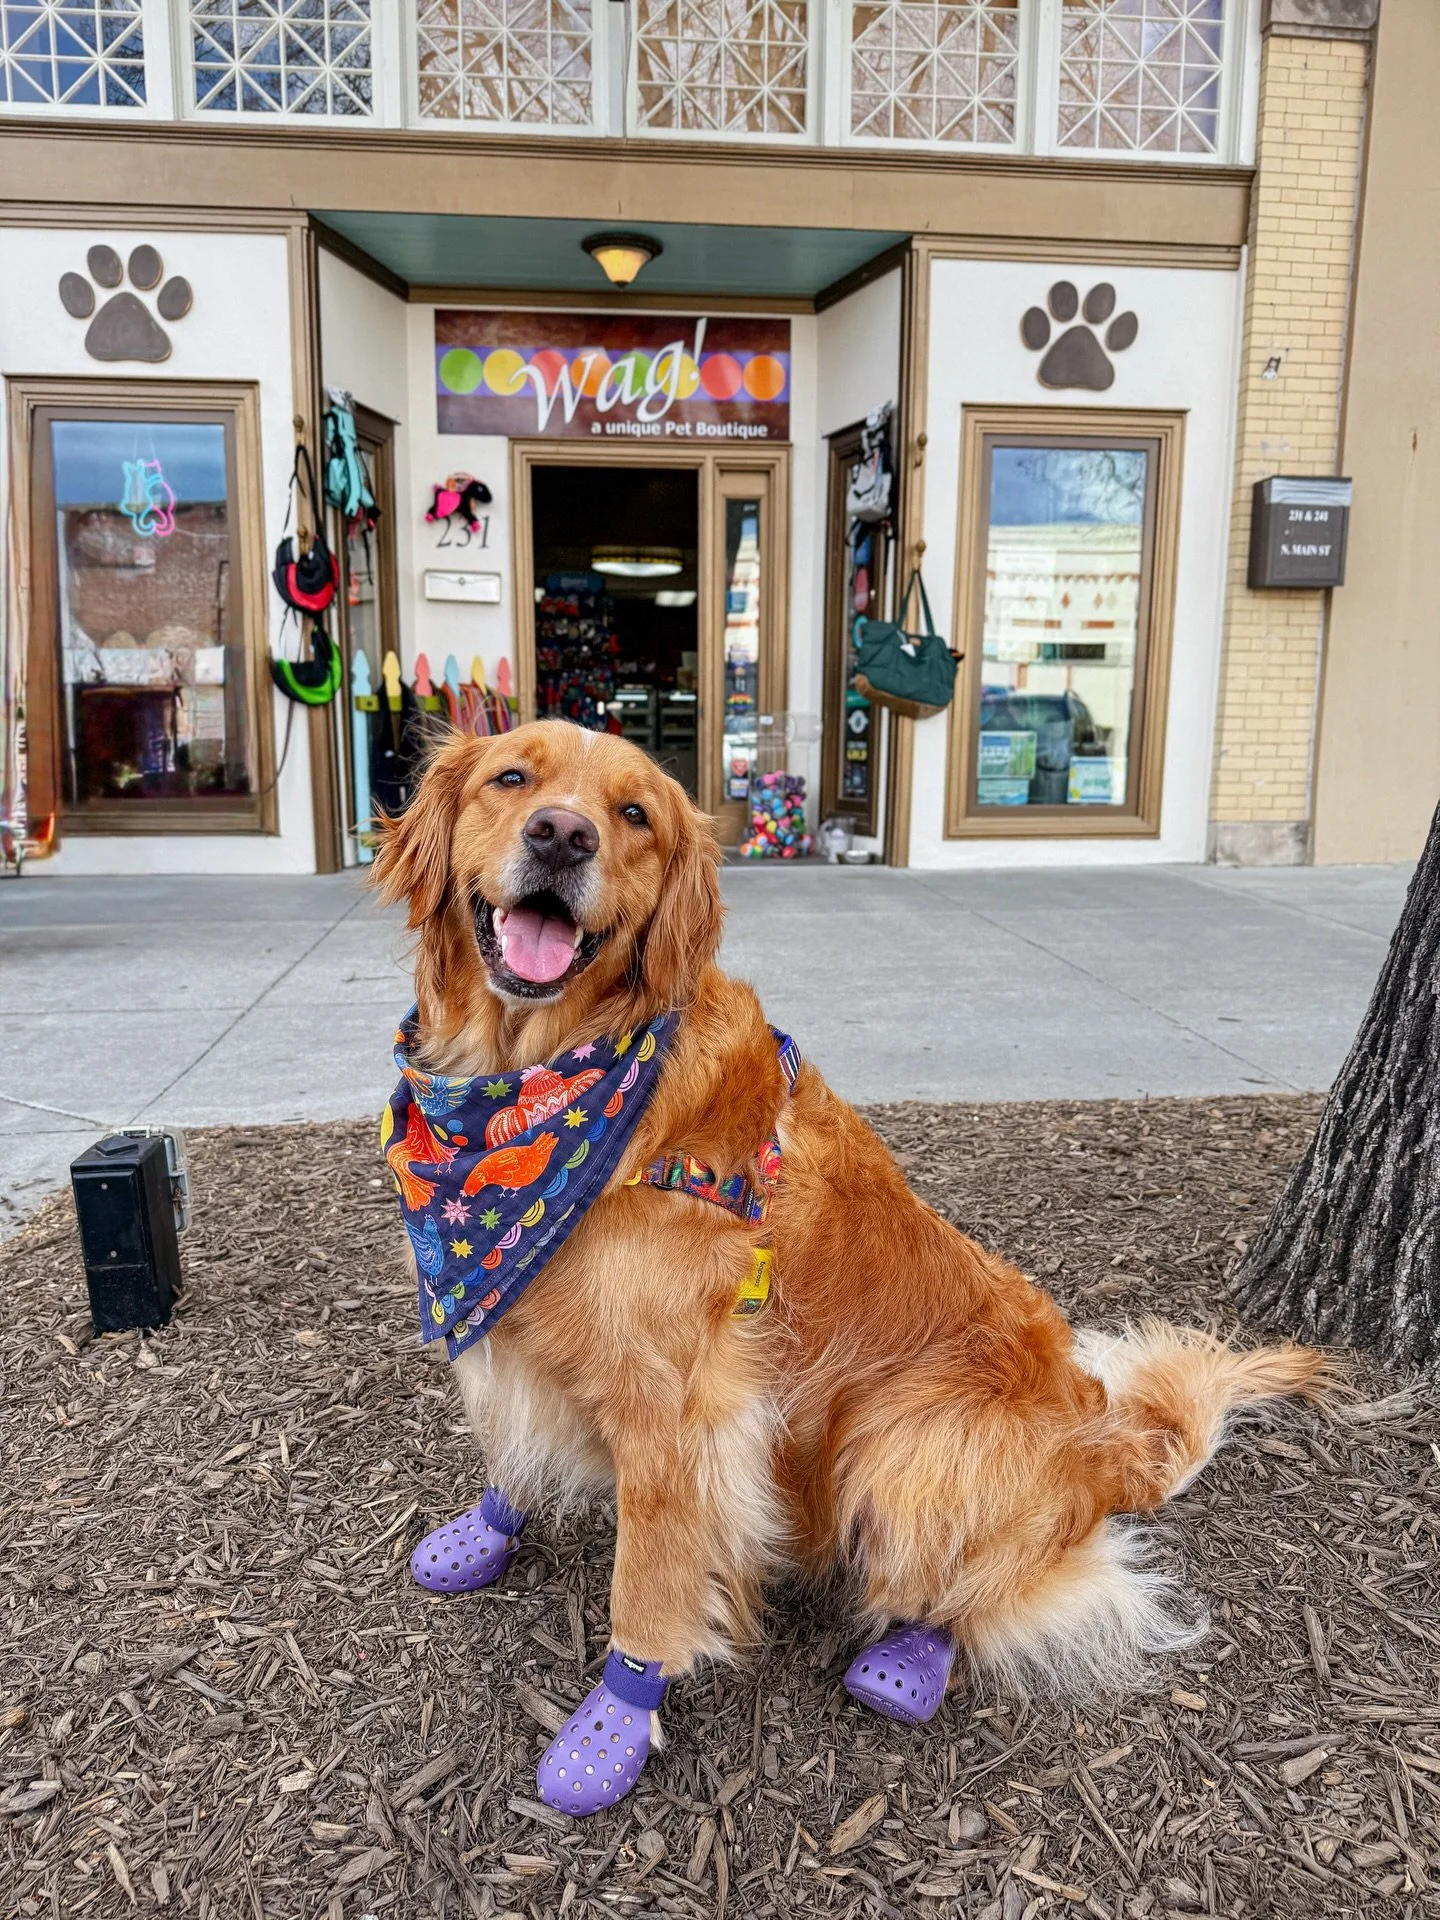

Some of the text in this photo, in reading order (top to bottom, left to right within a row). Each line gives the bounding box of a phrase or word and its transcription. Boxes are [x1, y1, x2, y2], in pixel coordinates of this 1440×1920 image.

[508, 317, 707, 432] Wag!
[591, 421, 768, 439] a unique Pet Boutique
[1292, 544, 1318, 557] MAIN
[1318, 545, 1332, 557] ST
